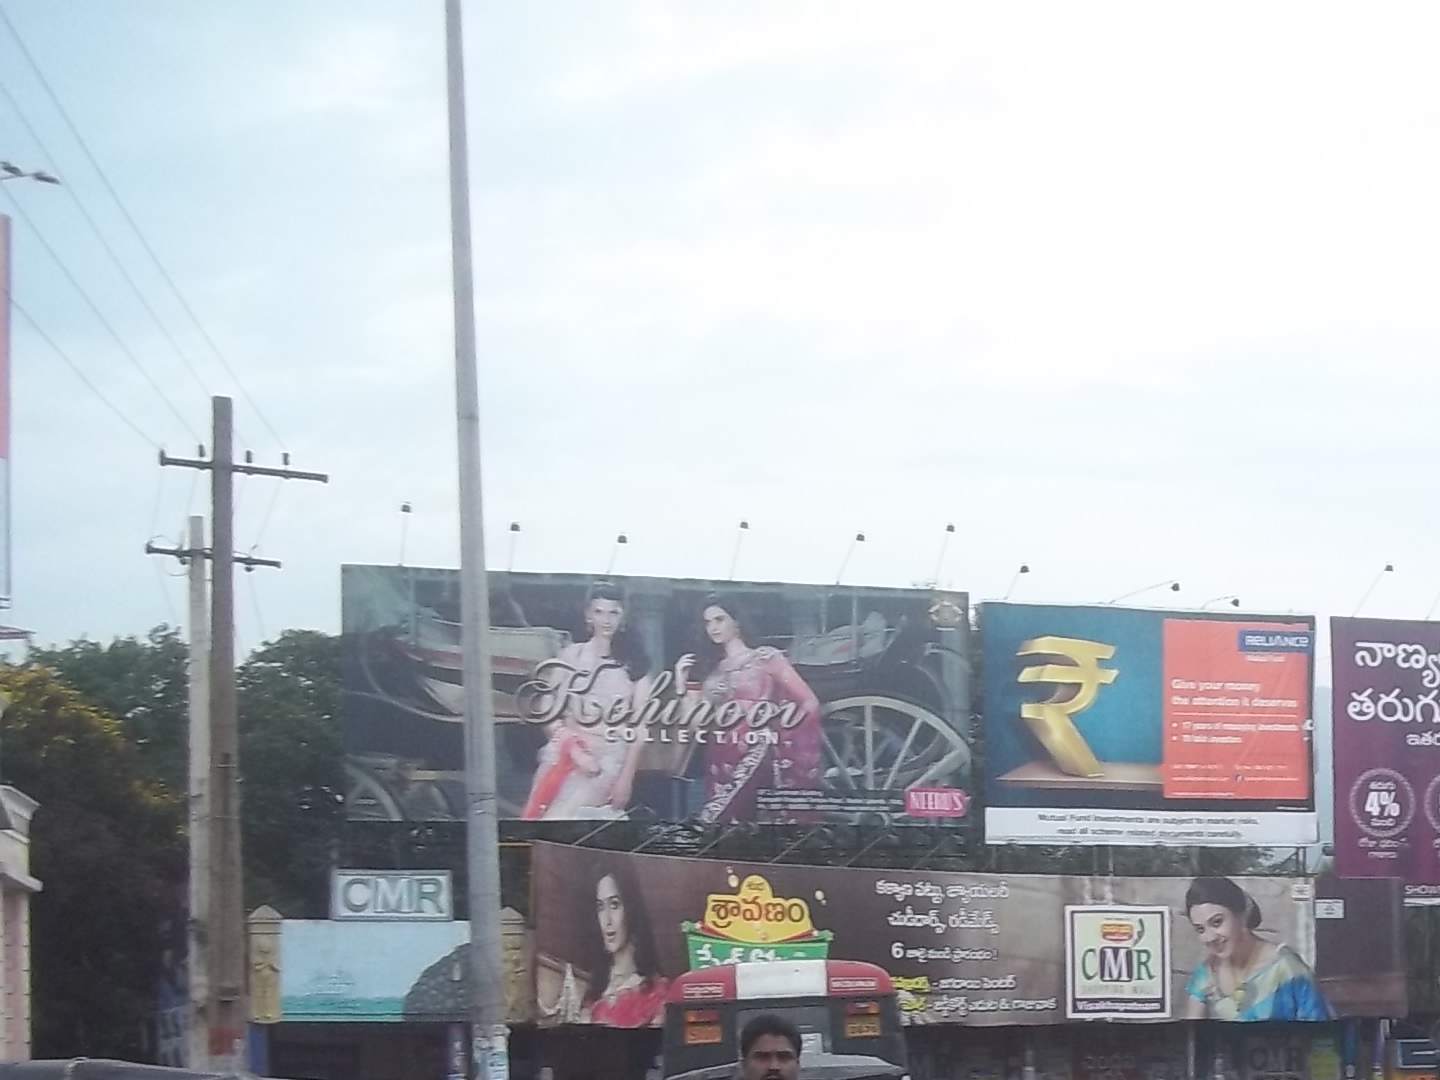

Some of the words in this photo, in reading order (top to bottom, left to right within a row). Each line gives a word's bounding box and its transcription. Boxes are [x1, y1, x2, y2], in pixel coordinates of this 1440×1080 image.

[1244, 635, 1310, 647] RELIANCE
[516, 657, 807, 729] Kohinoor
[1198, 681, 1224, 692] your
[604, 727, 779, 745] COLLECTION
[1364, 791, 1401, 817] 4%
[343, 878, 446, 914] CMR
[711, 896, 805, 929] శ్రావణం
[891, 942, 905, 959] 6
[1081, 947, 1157, 981] CMR
